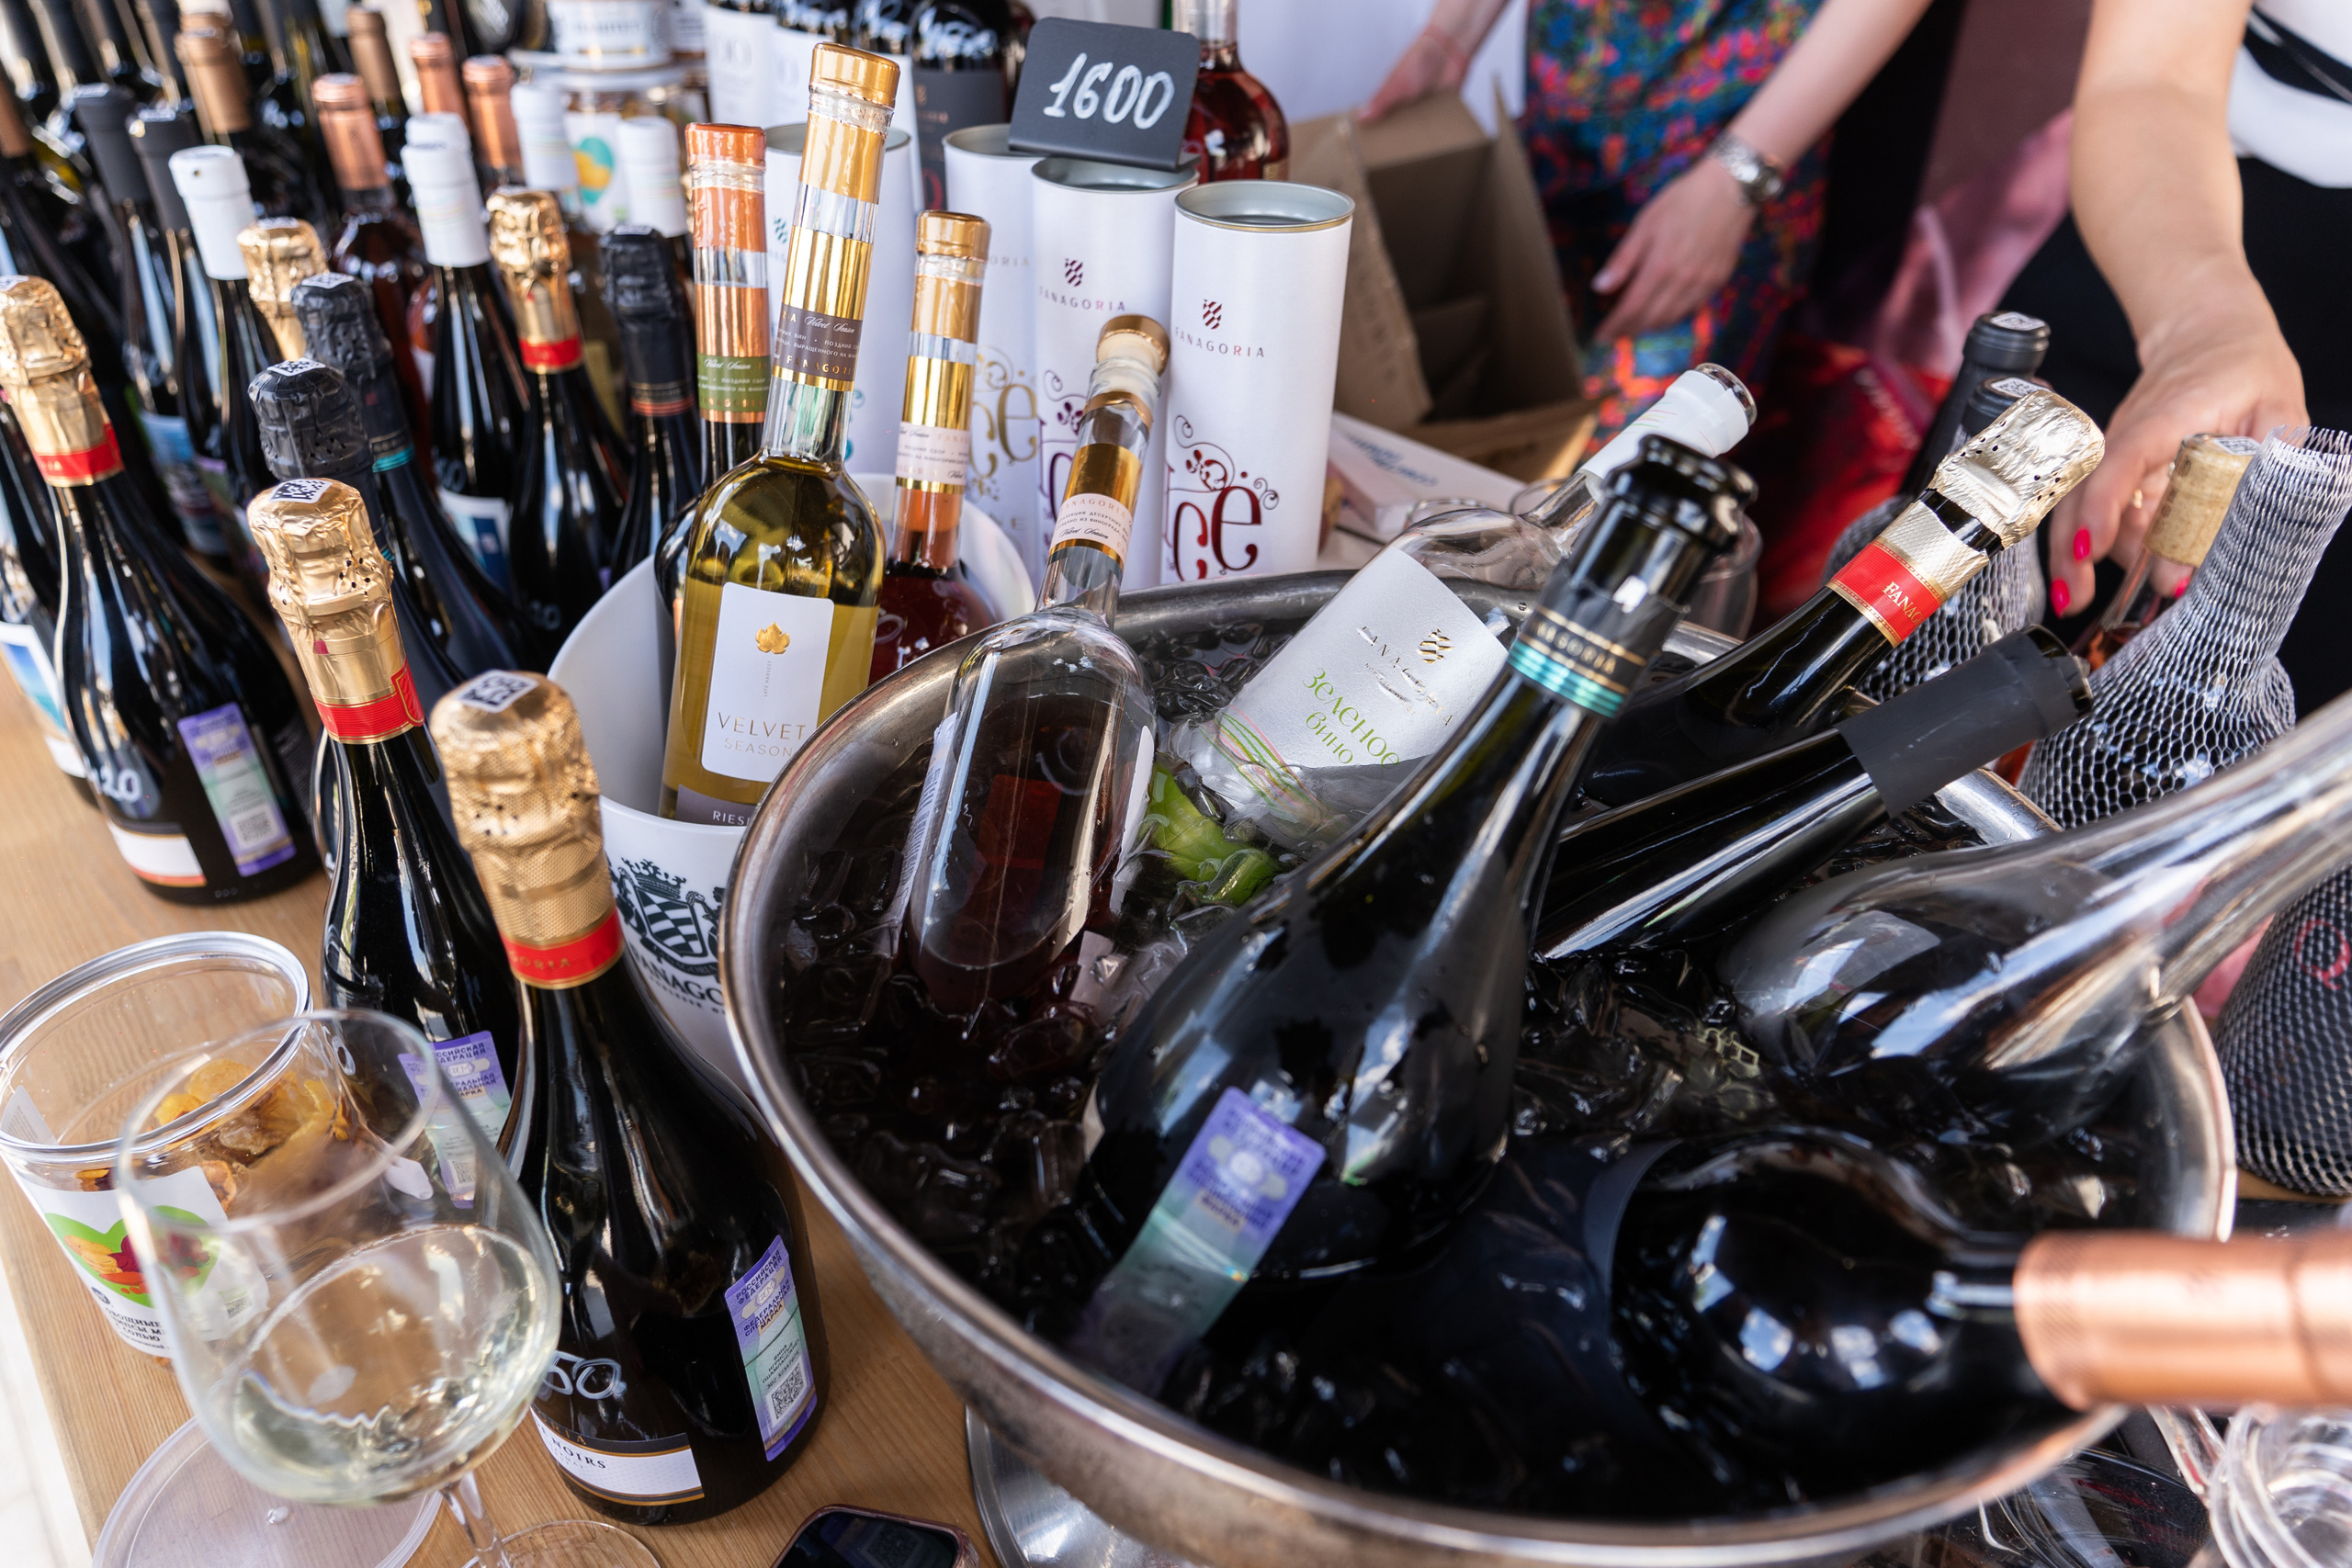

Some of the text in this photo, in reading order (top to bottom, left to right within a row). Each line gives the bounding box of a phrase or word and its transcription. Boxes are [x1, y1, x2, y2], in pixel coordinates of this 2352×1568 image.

[1043, 52, 1175, 130] 1600
[1039, 287, 1125, 311] FANAGORIA
[793, 343, 839, 356] ВЫРАЩЕННОГО
[1174, 326, 1265, 358] FANAGORIA
[718, 712, 806, 740] VELVET
[1306, 711, 1353, 764] вино
[736, 1249, 780, 1300] РОССИЙСКАЯ
[739, 1255, 783, 1304] ФЕДЕРАЦИЯ
[743, 1279, 789, 1331] ФЕДЕРАЛЬНАЯ
[745, 1284, 791, 1337] СПЕЦИАЛЬНАЯ
[760, 1303, 783, 1330] МАРКА
[551, 1437, 605, 1469] NOIRS
